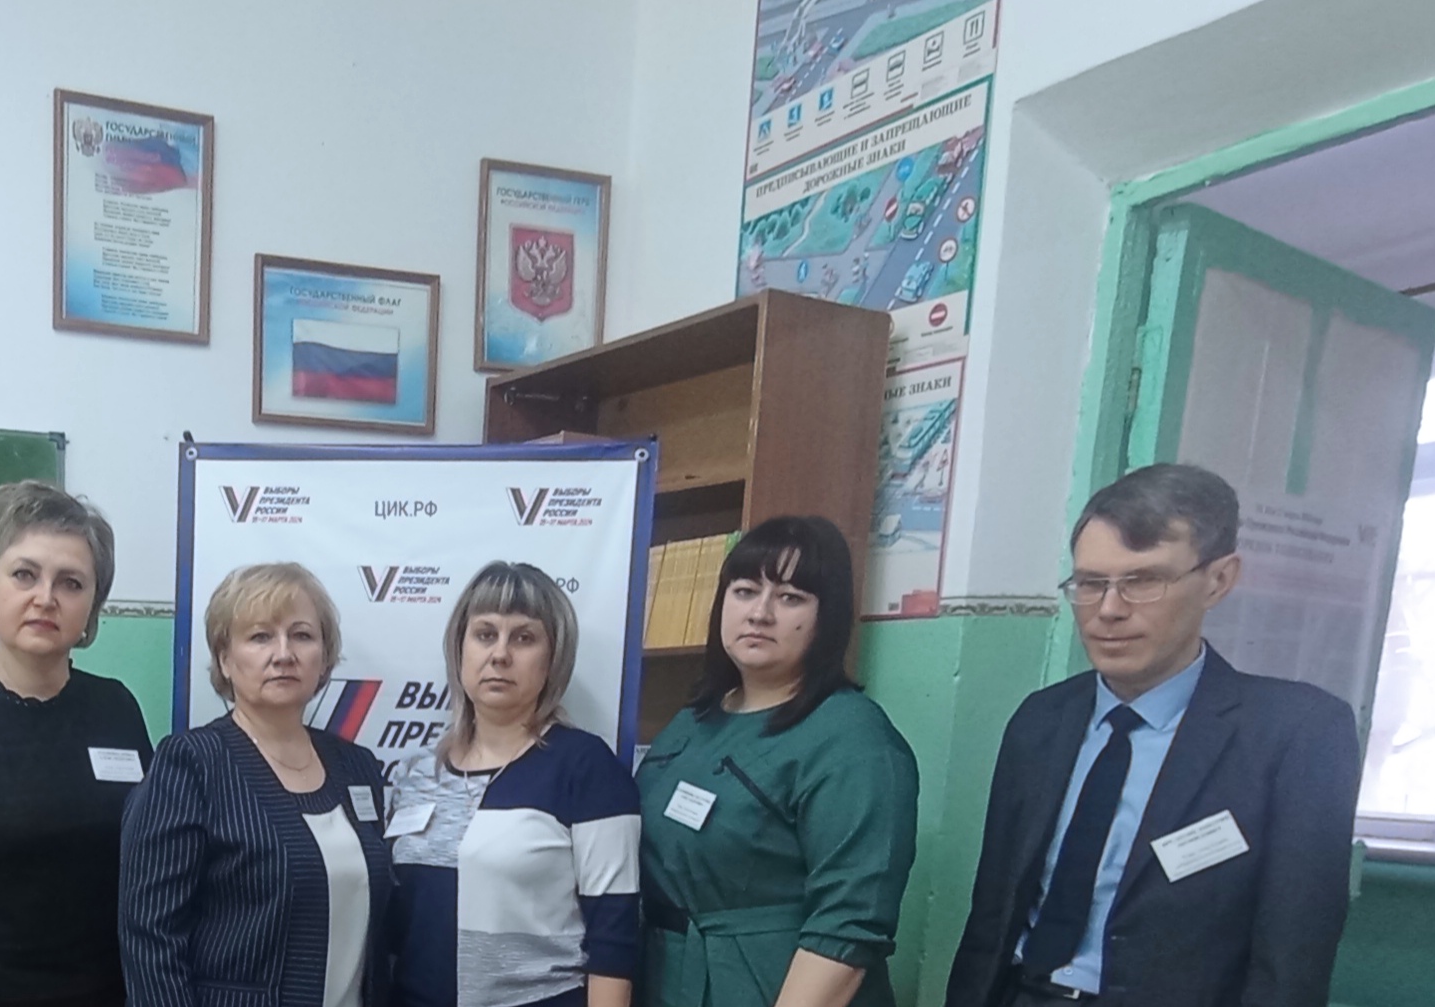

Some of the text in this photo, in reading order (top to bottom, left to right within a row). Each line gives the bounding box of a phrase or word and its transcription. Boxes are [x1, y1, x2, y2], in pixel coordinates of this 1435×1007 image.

[871, 94, 972, 147] ЗАПРЕЩАЮЩИЕ
[803, 139, 906, 194] ДОРОЖНЫЕ ЗНАКИ
[378, 297, 401, 306] ФЛАГ
[909, 376, 952, 395] ЗНАКИ
[264, 486, 300, 494] ВЫБОРЫ
[552, 488, 592, 496] ВЫБОРЫ
[259, 496, 310, 505] ПРЕЗИДЕНТА
[548, 498, 602, 507] ПРЕЗИДЕНТА
[255, 506, 288, 515] РОССИИ
[374, 500, 437, 519] ЦИК.РФ
[543, 508, 578, 517] РОССИИ
[403, 566, 440, 574] ВЫБОРЫ
[398, 576, 450, 585] ПРЕЗИДЕНТА
[393, 586, 427, 594] РОССИИ
